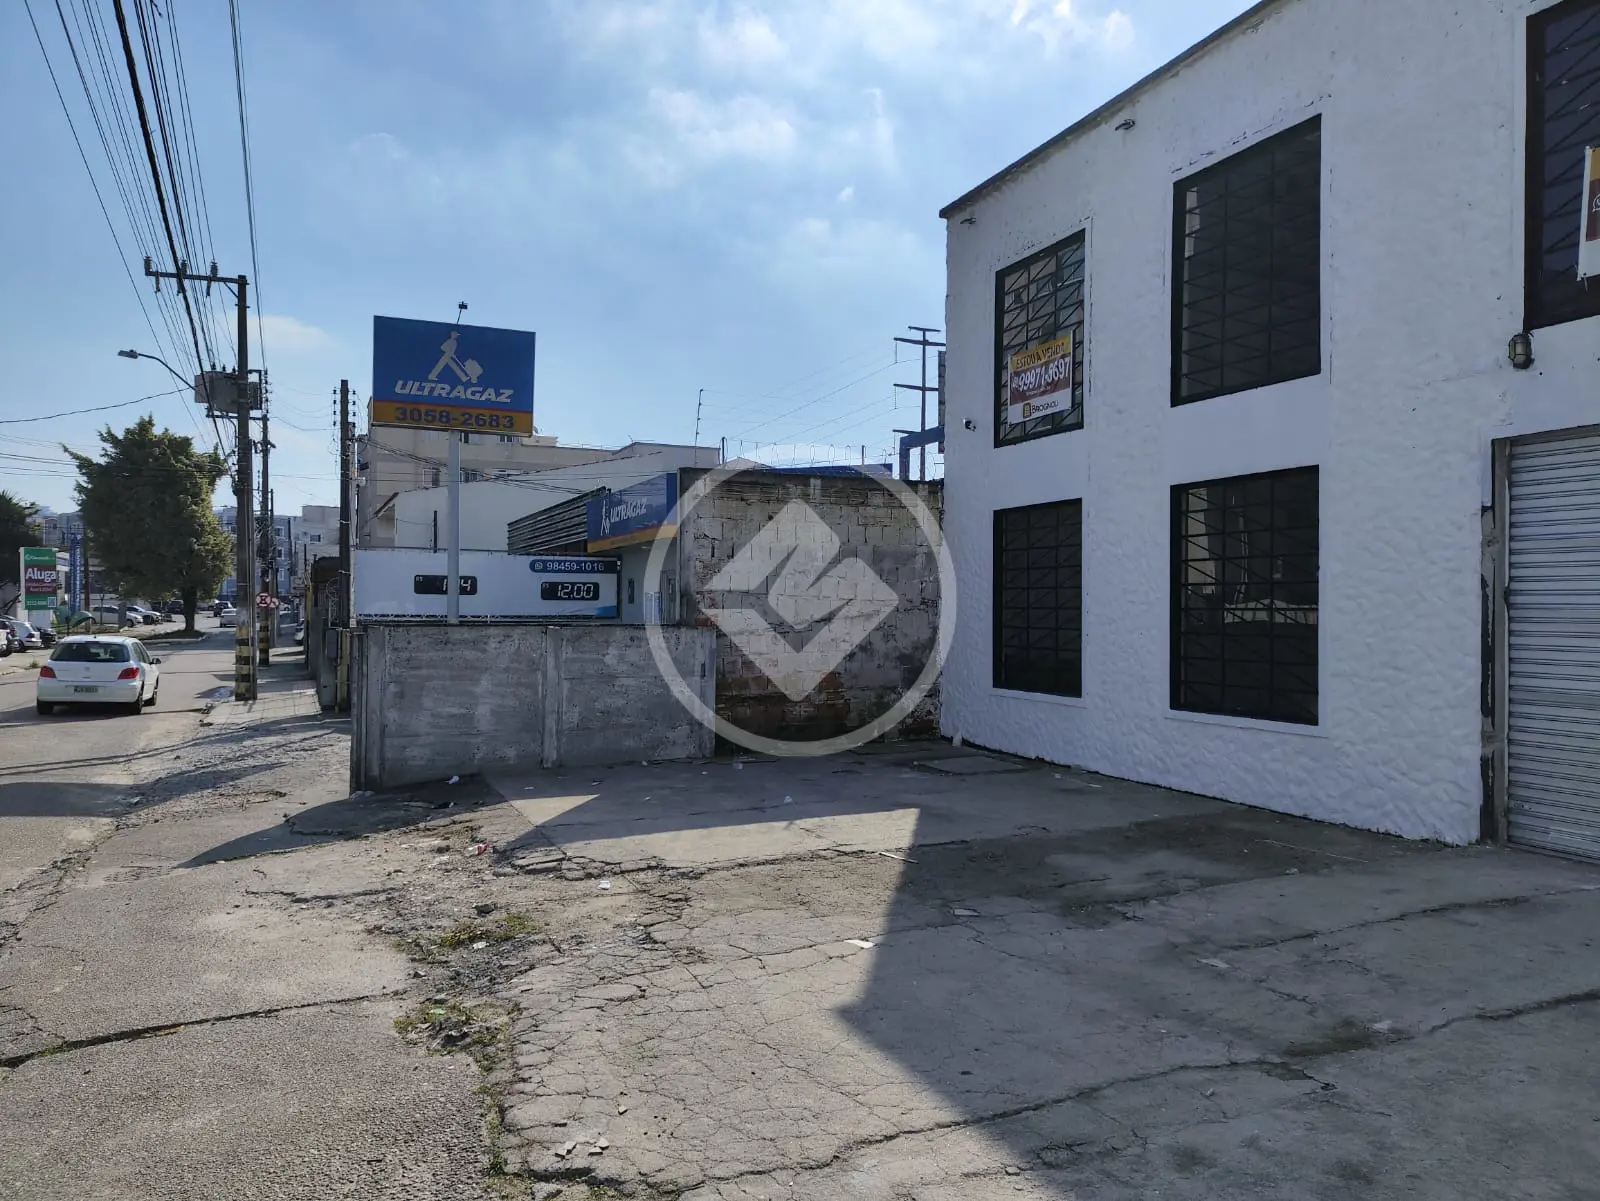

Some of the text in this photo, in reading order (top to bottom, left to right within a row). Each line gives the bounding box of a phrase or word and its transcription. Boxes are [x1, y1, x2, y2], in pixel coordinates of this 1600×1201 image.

[394, 380, 514, 403] ULTRAGAZ
[394, 406, 515, 429] 3058-2683
[610, 497, 647, 523] ULTRAGAZ
[25, 567, 57, 583] Aluga
[546, 562, 605, 571] 98459-1016
